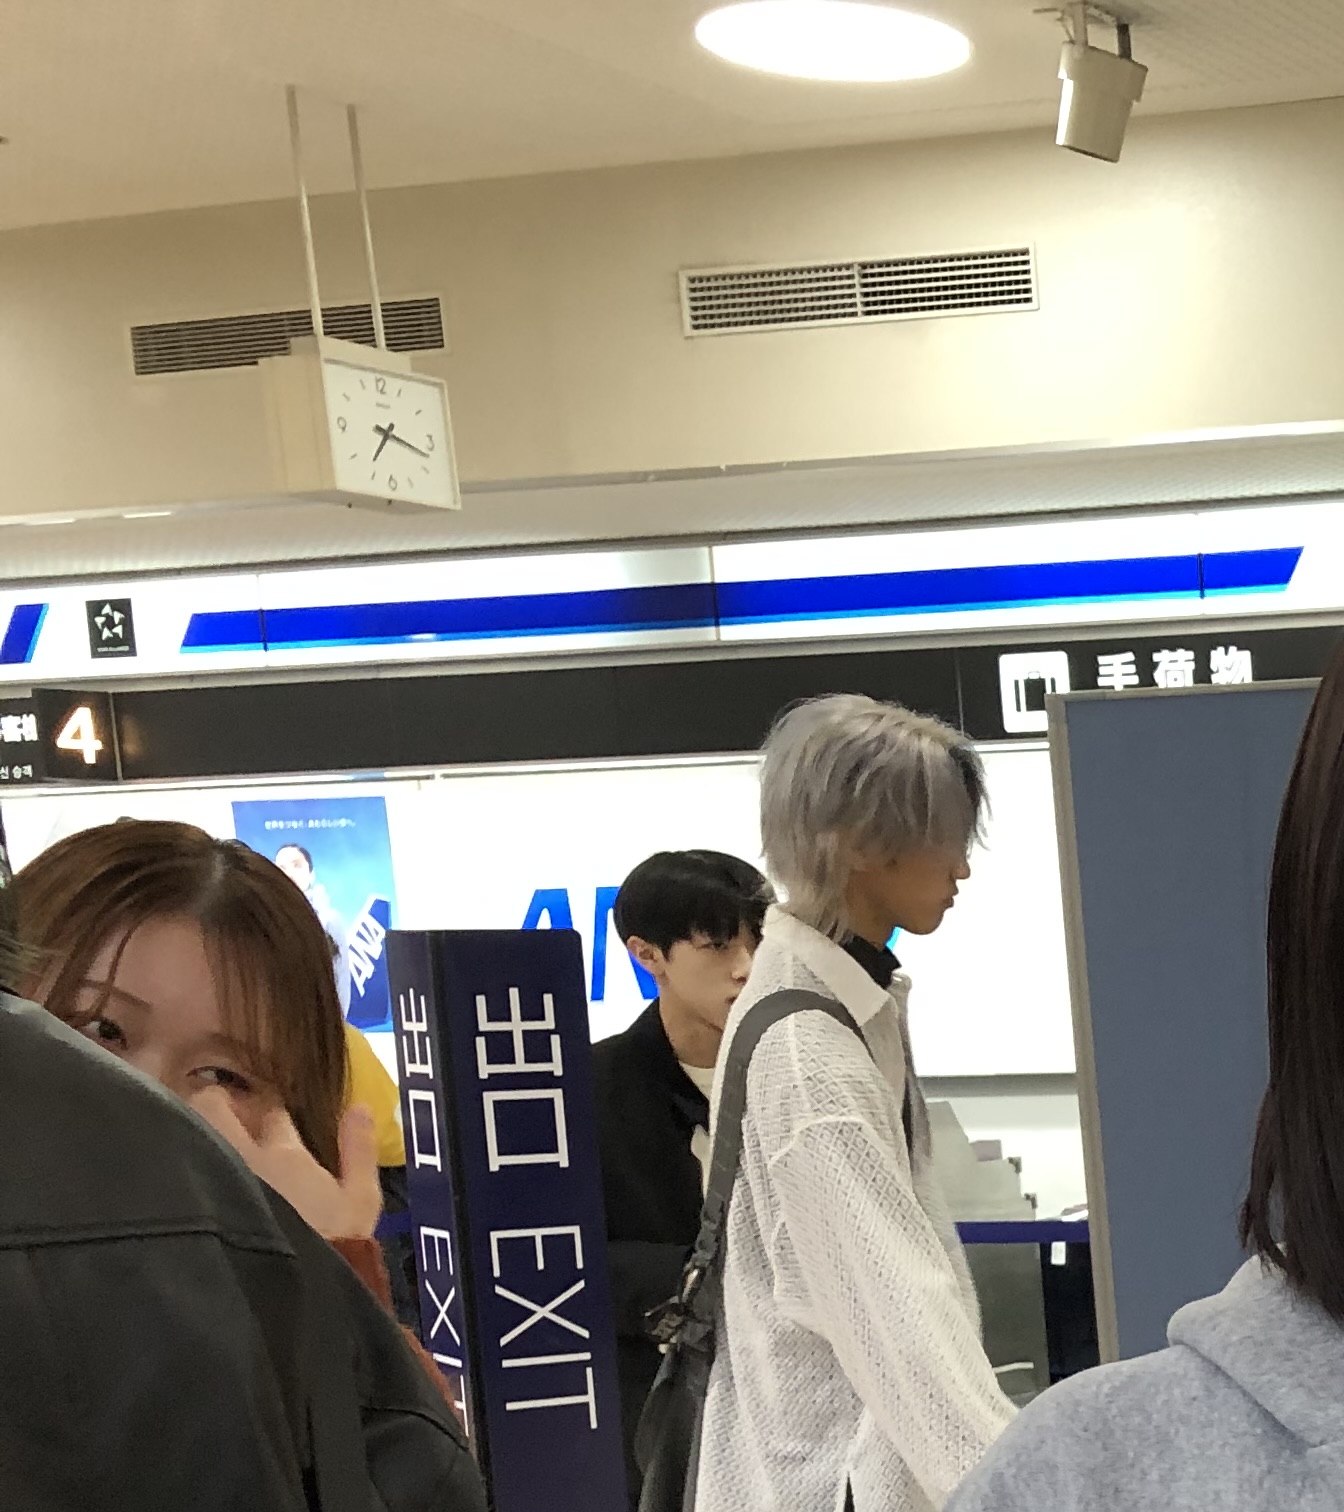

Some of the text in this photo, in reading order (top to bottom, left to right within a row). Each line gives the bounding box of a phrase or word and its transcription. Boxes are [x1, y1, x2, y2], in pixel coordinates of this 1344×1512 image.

[374, 376, 386, 395] 12
[426, 434, 435, 451] 3
[1096, 645, 1253, 692] 手荷物
[55, 706, 104, 765] 4
[399, 987, 443, 1173] 出口
[475, 986, 598, 1430] 出口 EXIT
